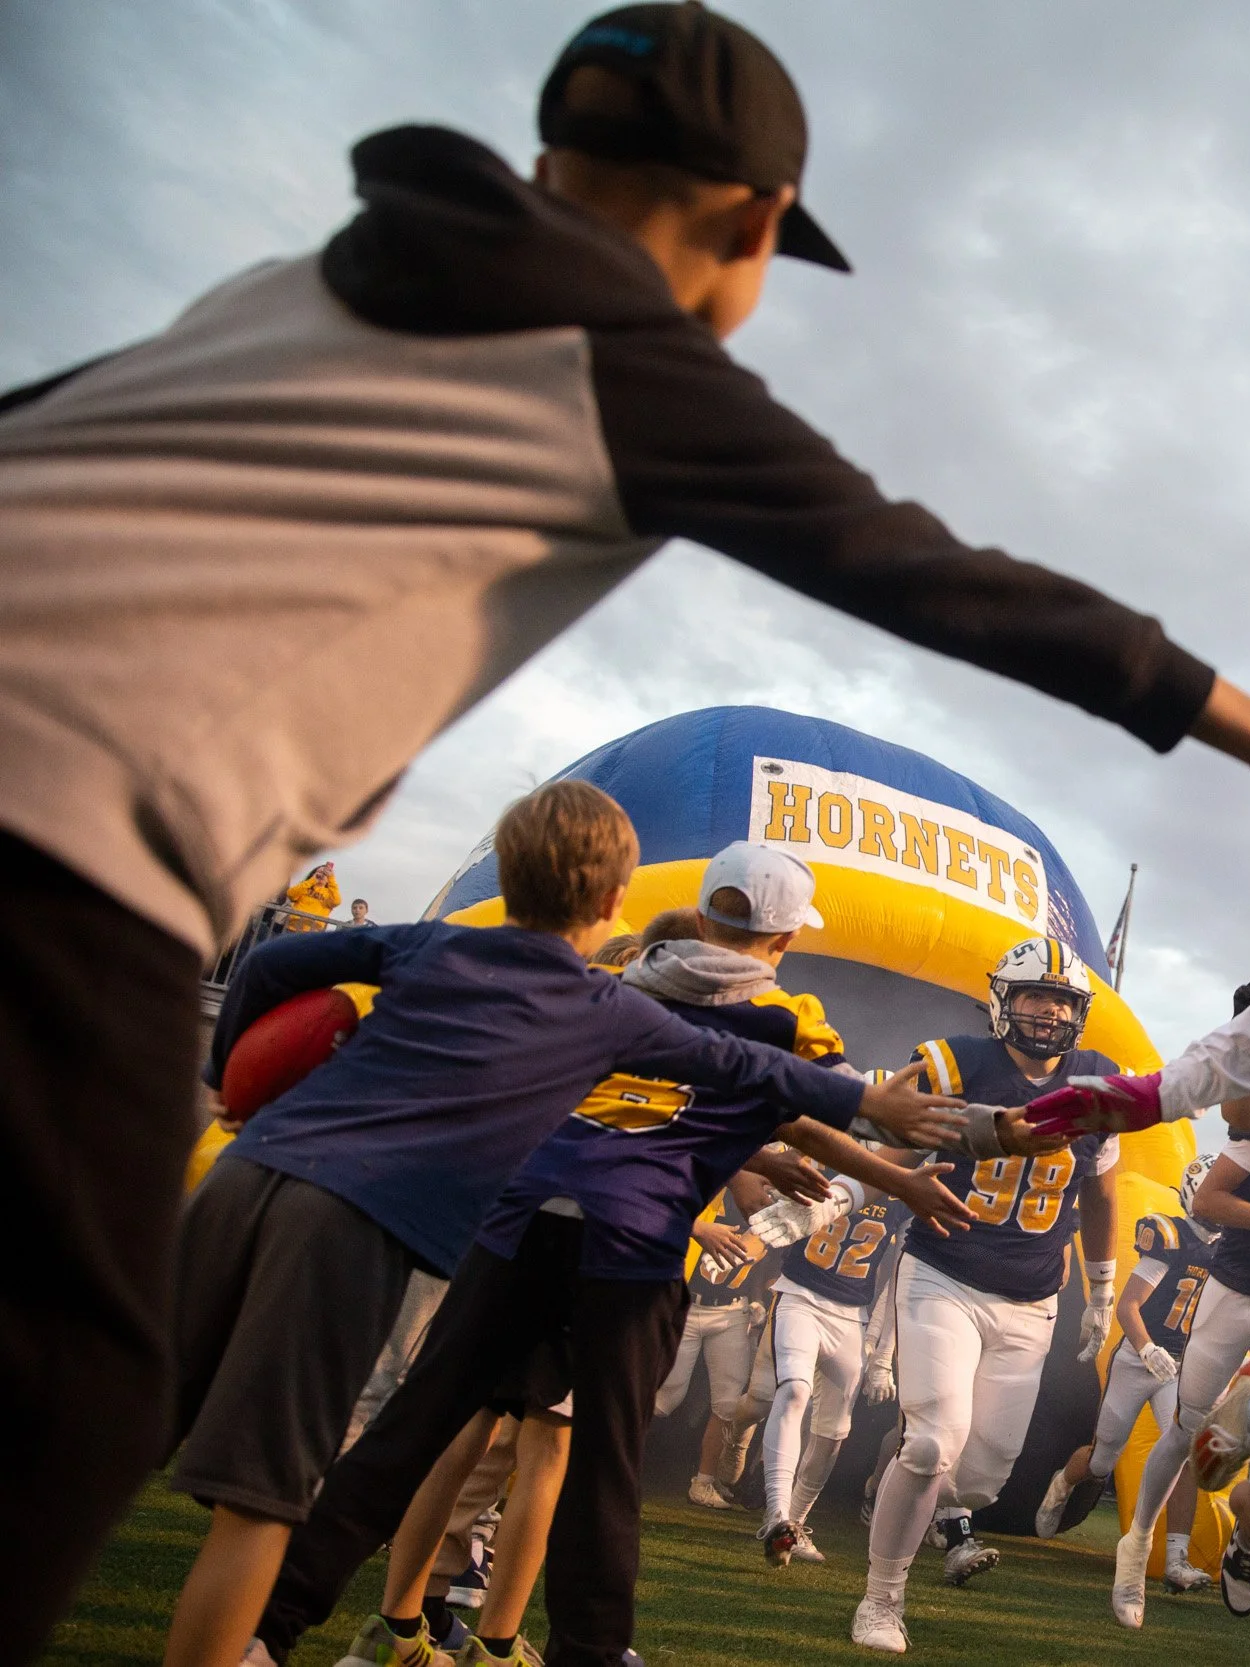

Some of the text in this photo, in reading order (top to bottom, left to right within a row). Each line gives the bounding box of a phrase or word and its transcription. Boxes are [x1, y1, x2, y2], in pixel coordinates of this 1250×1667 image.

[765, 781, 1040, 922] HORNETS
[965, 1144, 1077, 1233] 98
[803, 1215, 887, 1279] 82
